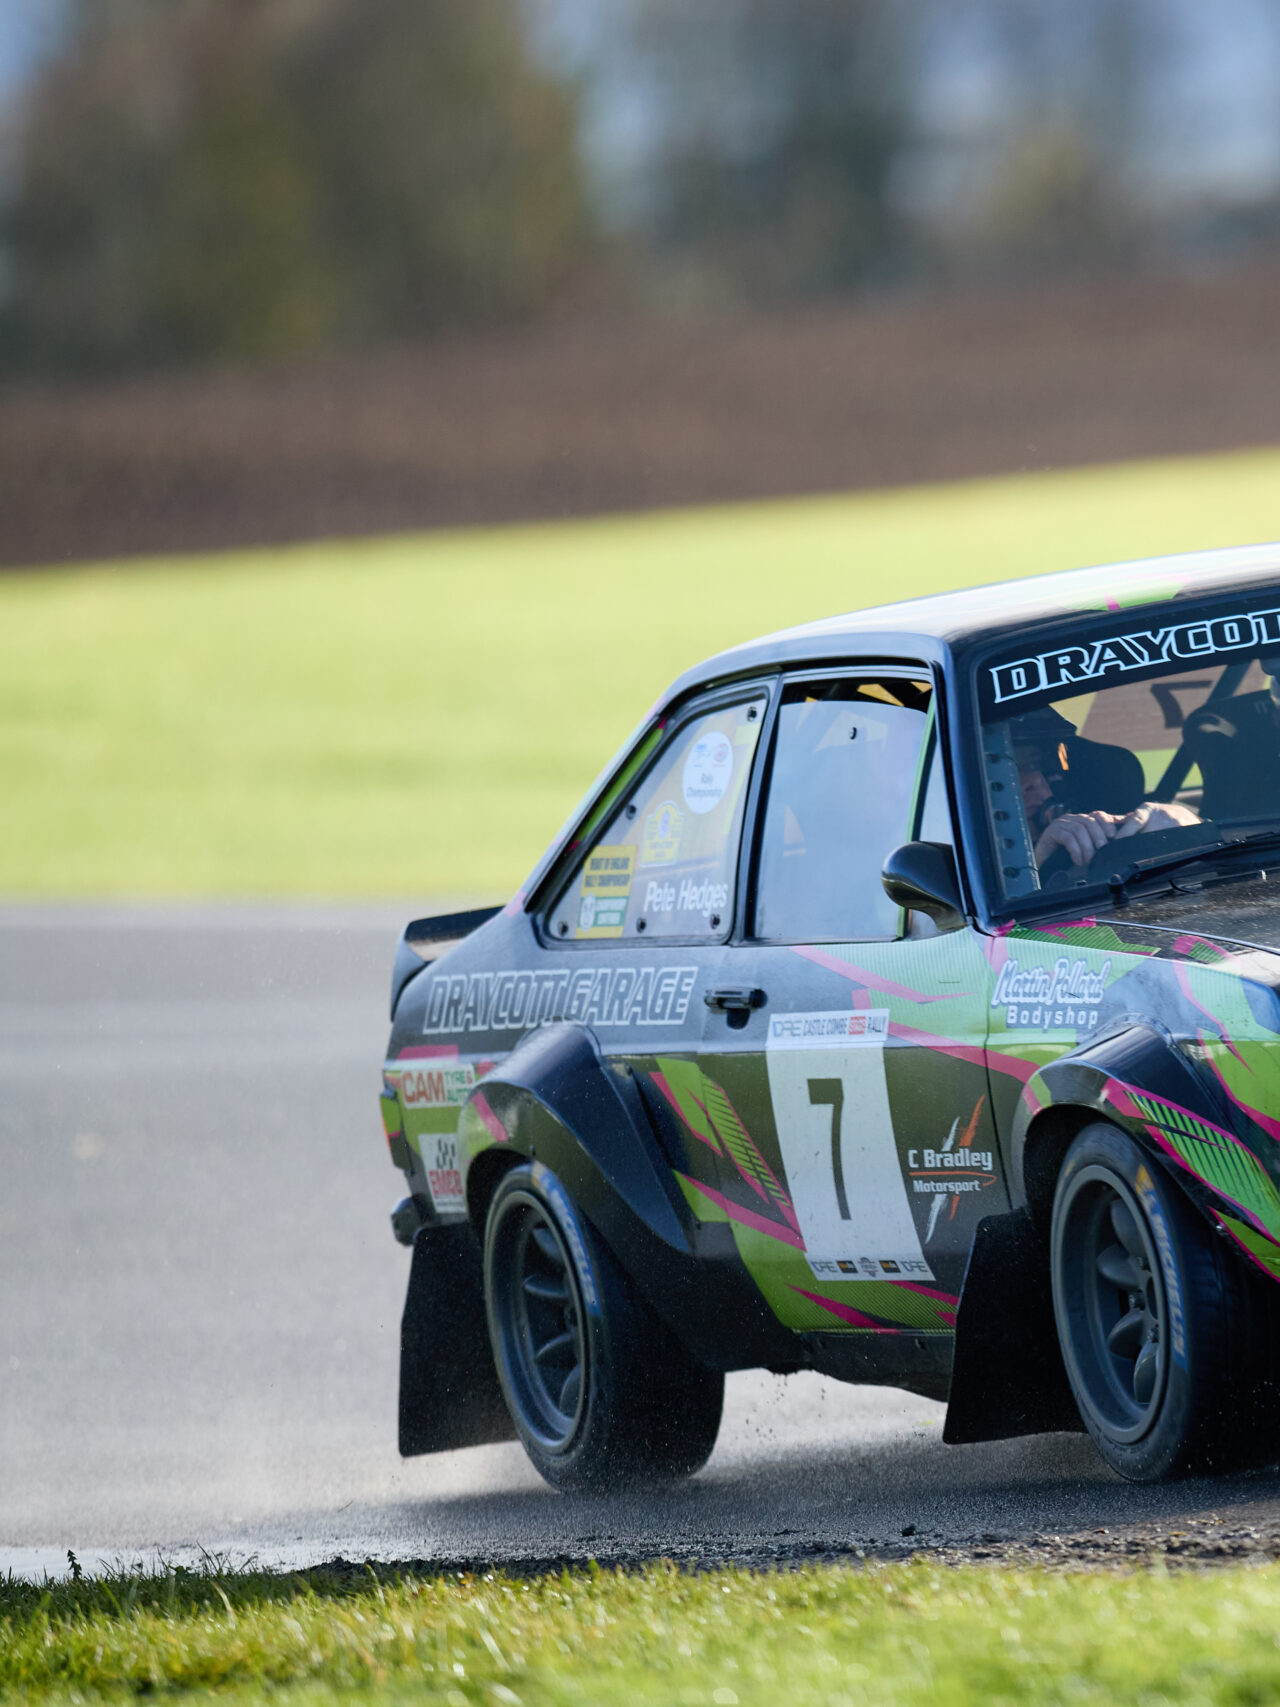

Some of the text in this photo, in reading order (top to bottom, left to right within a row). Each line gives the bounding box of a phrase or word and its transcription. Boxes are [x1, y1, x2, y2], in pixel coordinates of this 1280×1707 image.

[643, 877, 728, 918] Pete Hedges
[1044, 957, 1112, 1006] Pollard
[422, 966, 699, 1034] DRAYCOTT GARAGE
[1006, 1005, 1099, 1030] Bodyshop
[402, 1071, 446, 1103] CAM
[806, 1078, 852, 1220] 7
[907, 1147, 993, 1171] C Bradley
[913, 1179, 982, 1195] Motorsport
